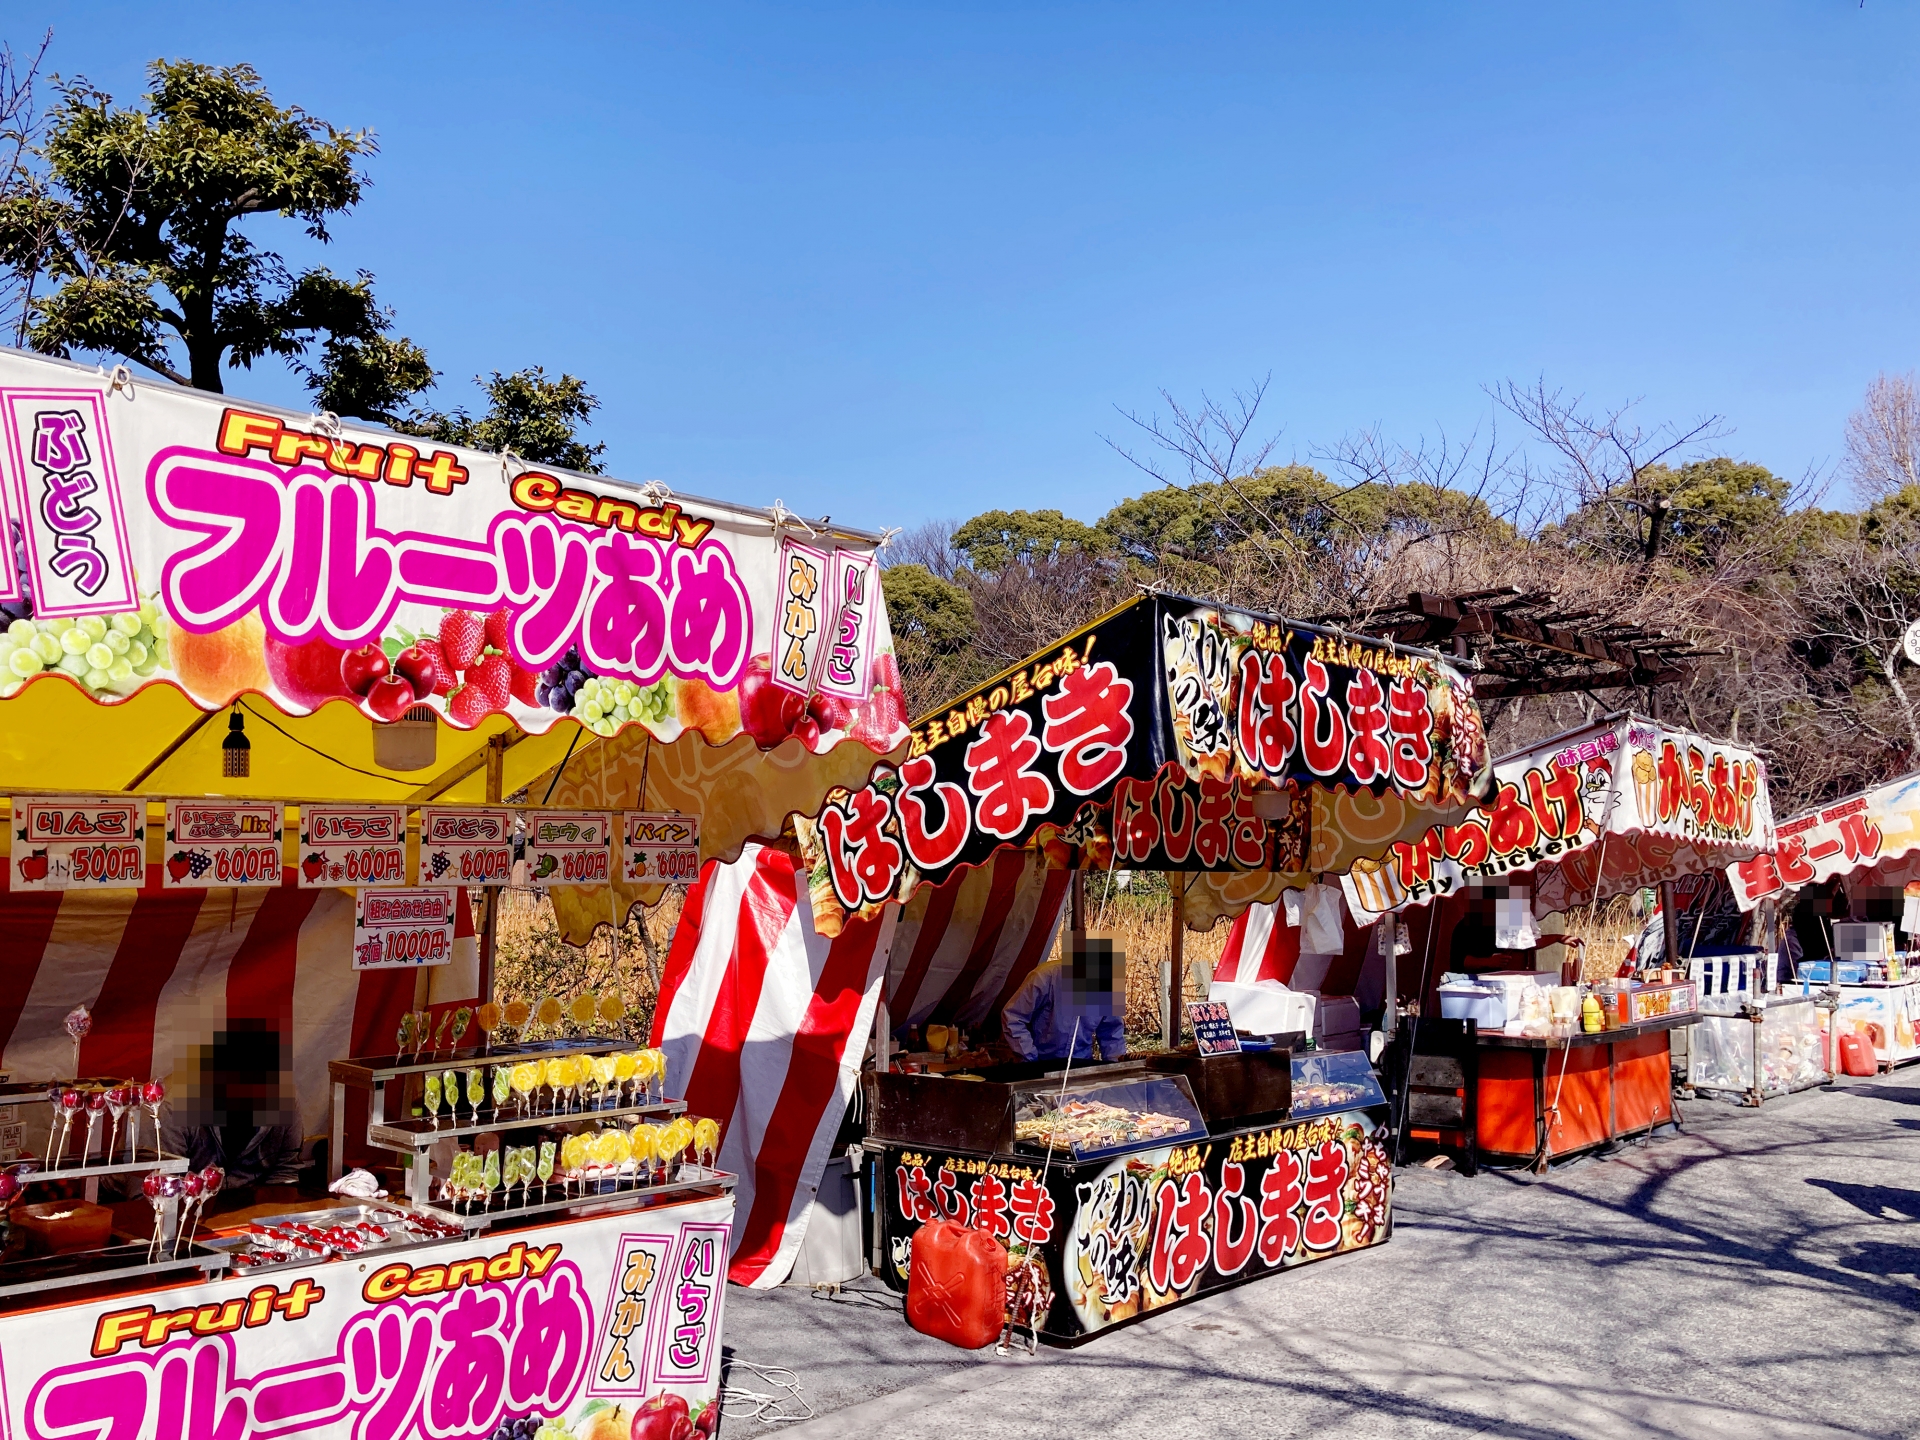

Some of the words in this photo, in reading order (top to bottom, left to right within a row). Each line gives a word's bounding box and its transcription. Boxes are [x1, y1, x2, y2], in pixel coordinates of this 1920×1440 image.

[217, 407, 469, 495] Fruit
[510, 471, 715, 549] Candy
[31, 409, 109, 596] ぶどう
[145, 445, 753, 693] フルーツあめ
[782, 556, 818, 681] みかん
[1910, 638, 1918, 647] 9
[1238, 649, 1433, 790] はしまき
[1555, 733, 1619, 768] 味自慢
[817, 661, 1134, 913] はしまき
[1657, 738, 1757, 838] からあげ
[36, 811, 127, 835] りんご
[181, 811, 236, 825] いちご
[189, 824, 242, 838] ぶどう
[241, 815, 271, 834] Mix
[315, 817, 392, 838] いちご
[433, 818, 500, 840] ぶどう
[538, 823, 596, 842] キウィ
[635, 823, 689, 842] パイン
[1113, 764, 1266, 868] はしまき
[1391, 758, 1584, 890] からあげ
[1775, 816, 1819, 840] BEER
[1821, 797, 1869, 824] BEER
[72, 845, 141, 881] 500円
[214, 847, 278, 881] 600円
[321, 862, 344, 881] 1本
[345, 848, 402, 881] 600円
[459, 849, 512, 880] 600円
[564, 851, 608, 880] 600円
[657, 851, 698, 880] 600円
[1409, 875, 1452, 901] Fly
[1460, 834, 1583, 878] Chicken
[1738, 815, 1883, 901] 生ビール
[368, 898, 443, 920] 組み合わせ自由
[359, 942, 382, 963] 2個
[385, 928, 446, 961] 1000円
[1228, 1117, 1343, 1163] 店主自慢の屋台味!
[1168, 1144, 1212, 1177] 絶品!
[895, 1165, 1056, 1244] はしまき
[1146, 1141, 1349, 1296] はしまき
[90, 1278, 325, 1358] Fruit
[362, 1241, 563, 1304] Candy
[601, 1249, 656, 1383] みかん
[669, 1237, 714, 1369] いちご
